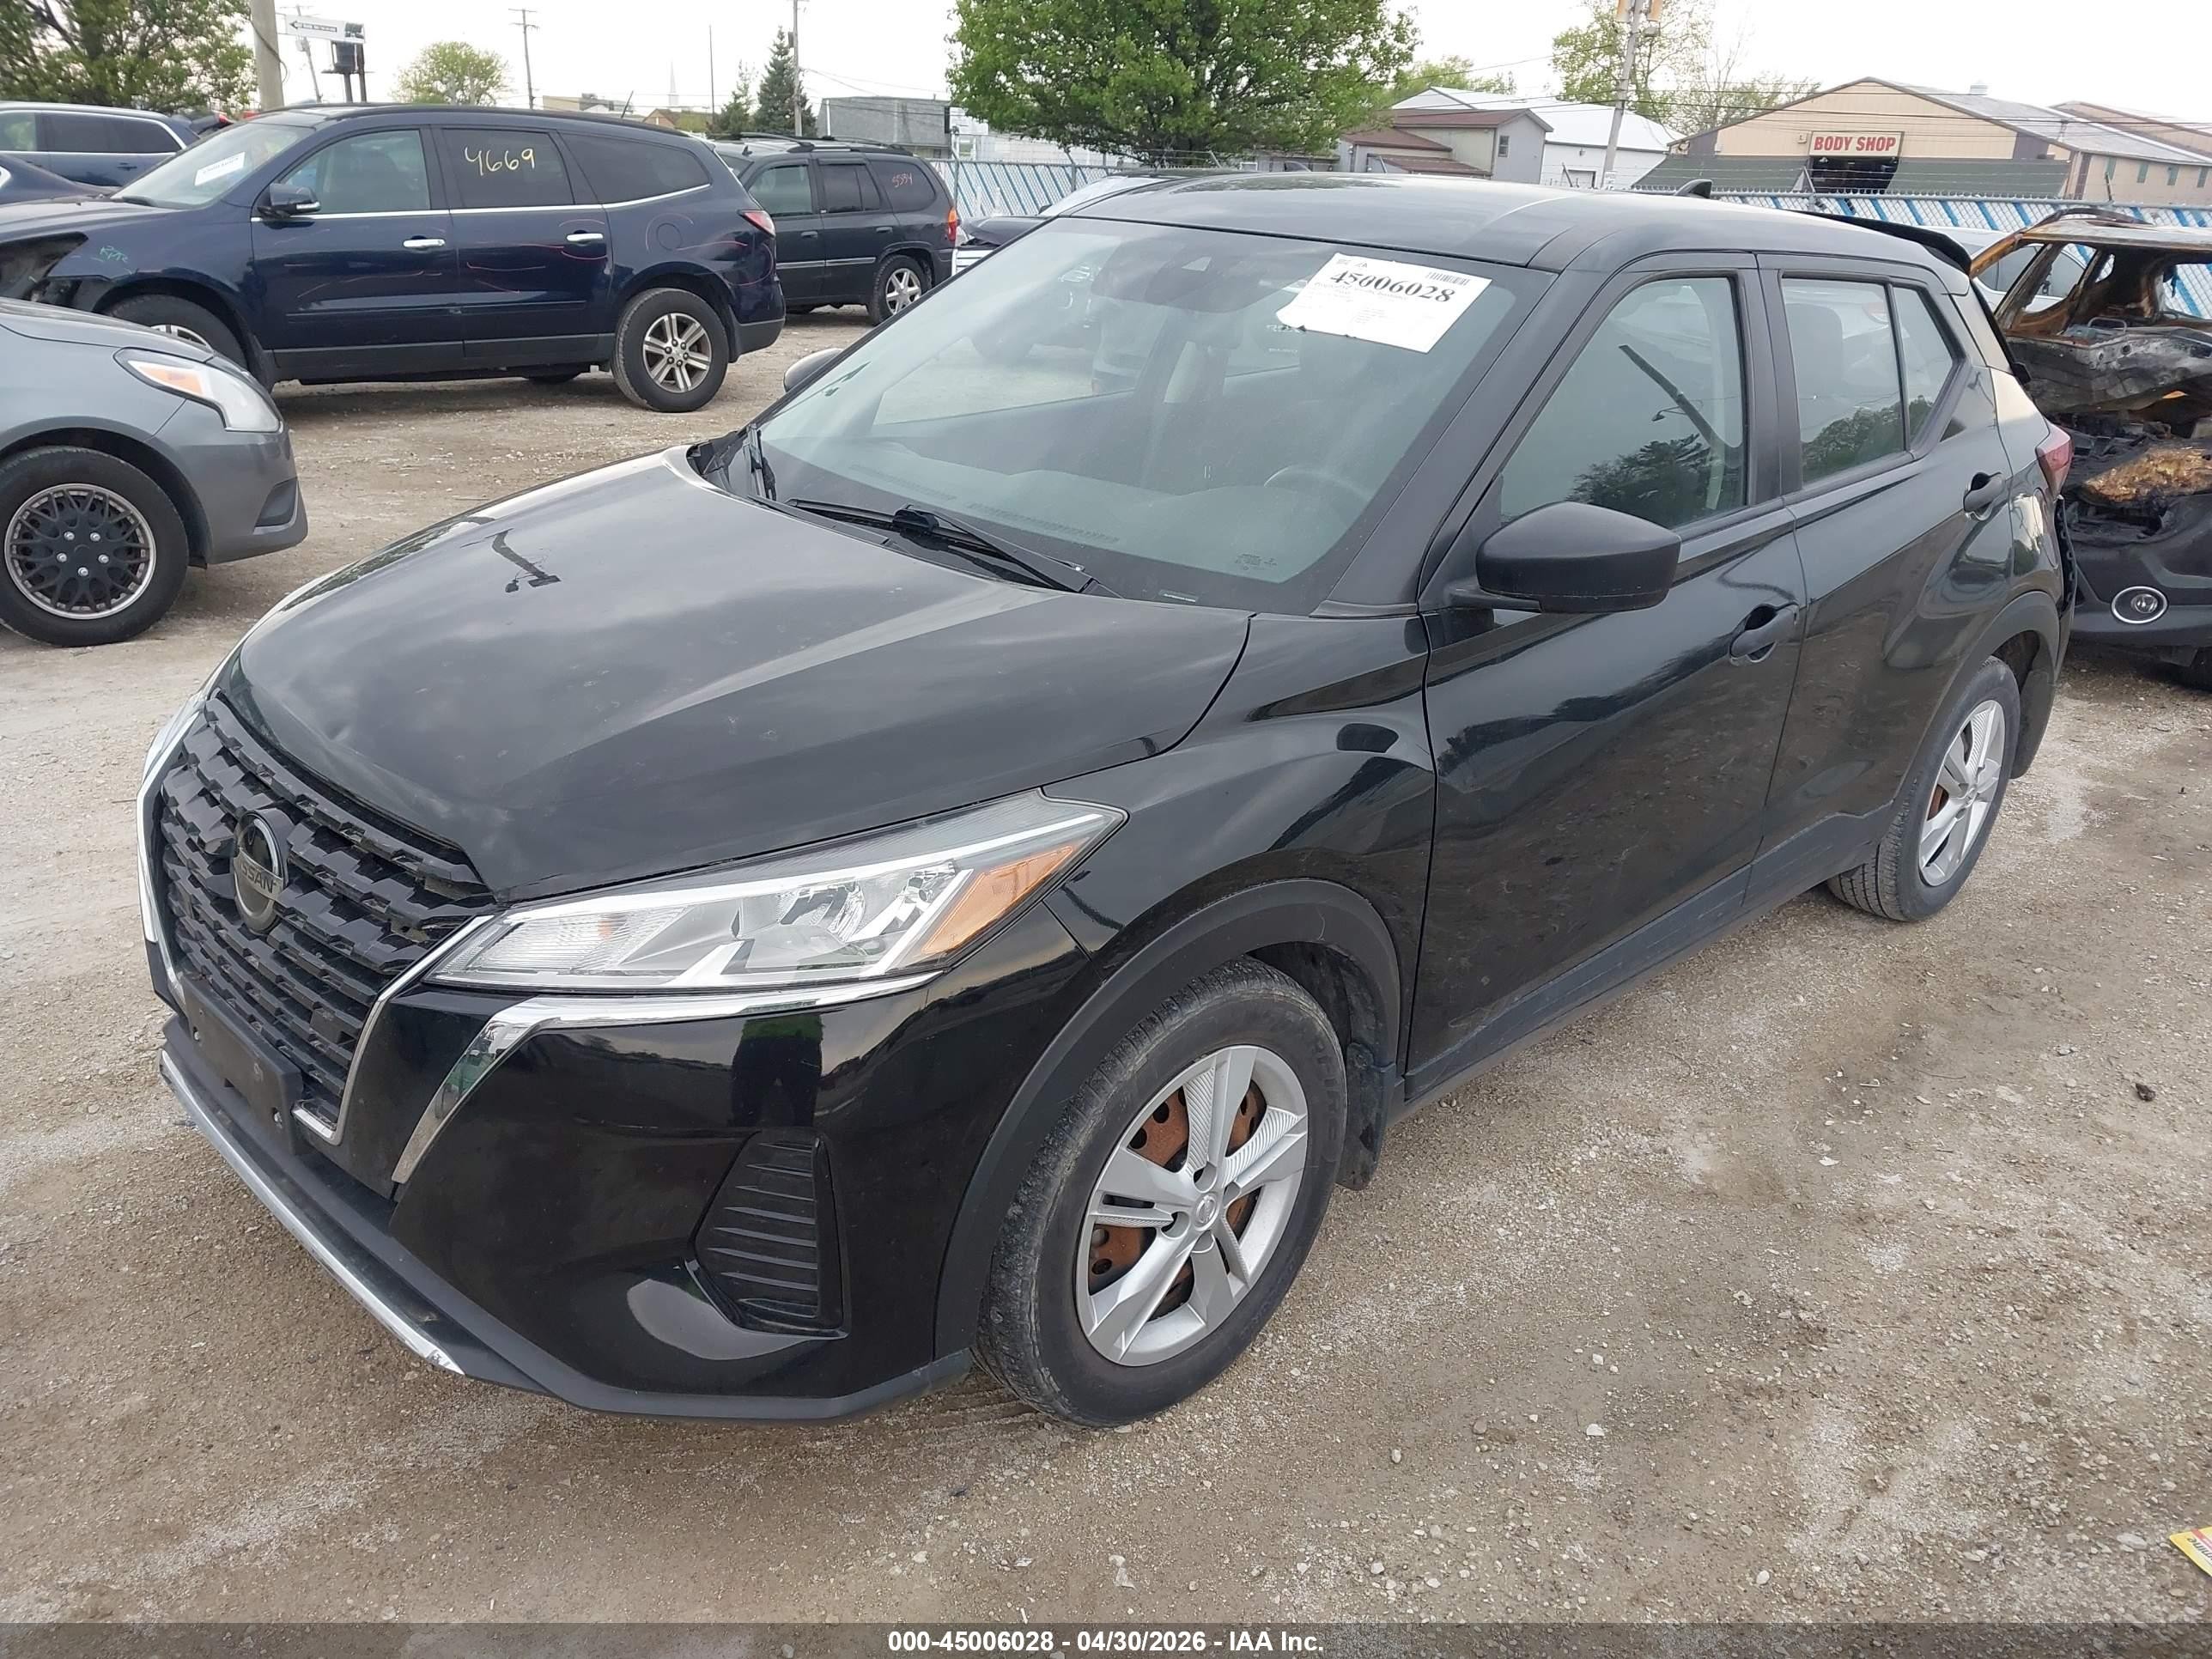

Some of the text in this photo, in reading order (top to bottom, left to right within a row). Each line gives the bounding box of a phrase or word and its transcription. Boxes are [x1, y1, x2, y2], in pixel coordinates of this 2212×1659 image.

[1814, 136, 1896, 152] BODY SHOP
[465, 147, 535, 176] 4669
[1330, 270, 1455, 302] 45006028
